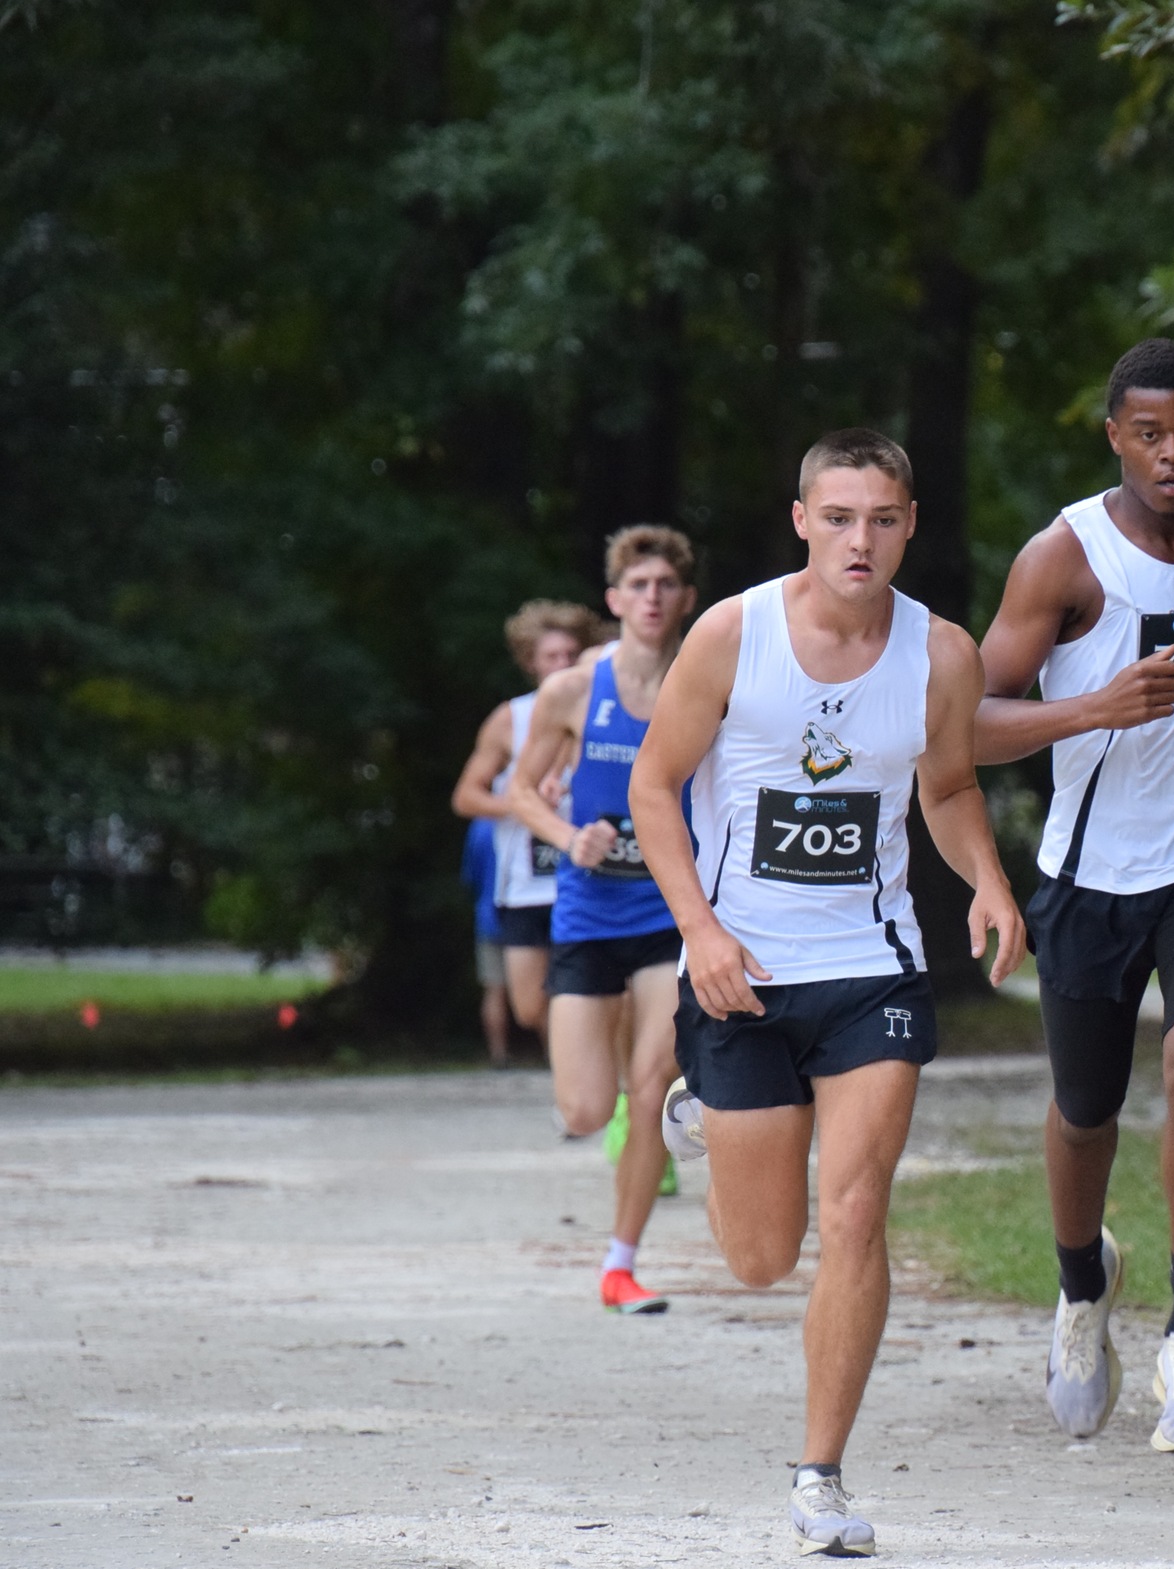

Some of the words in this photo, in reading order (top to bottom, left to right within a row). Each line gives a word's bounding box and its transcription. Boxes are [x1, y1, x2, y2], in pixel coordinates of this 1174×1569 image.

[593, 699, 615, 727] E
[772, 819, 861, 856] 703
[769, 865, 857, 877] www.milesandminutes.net
